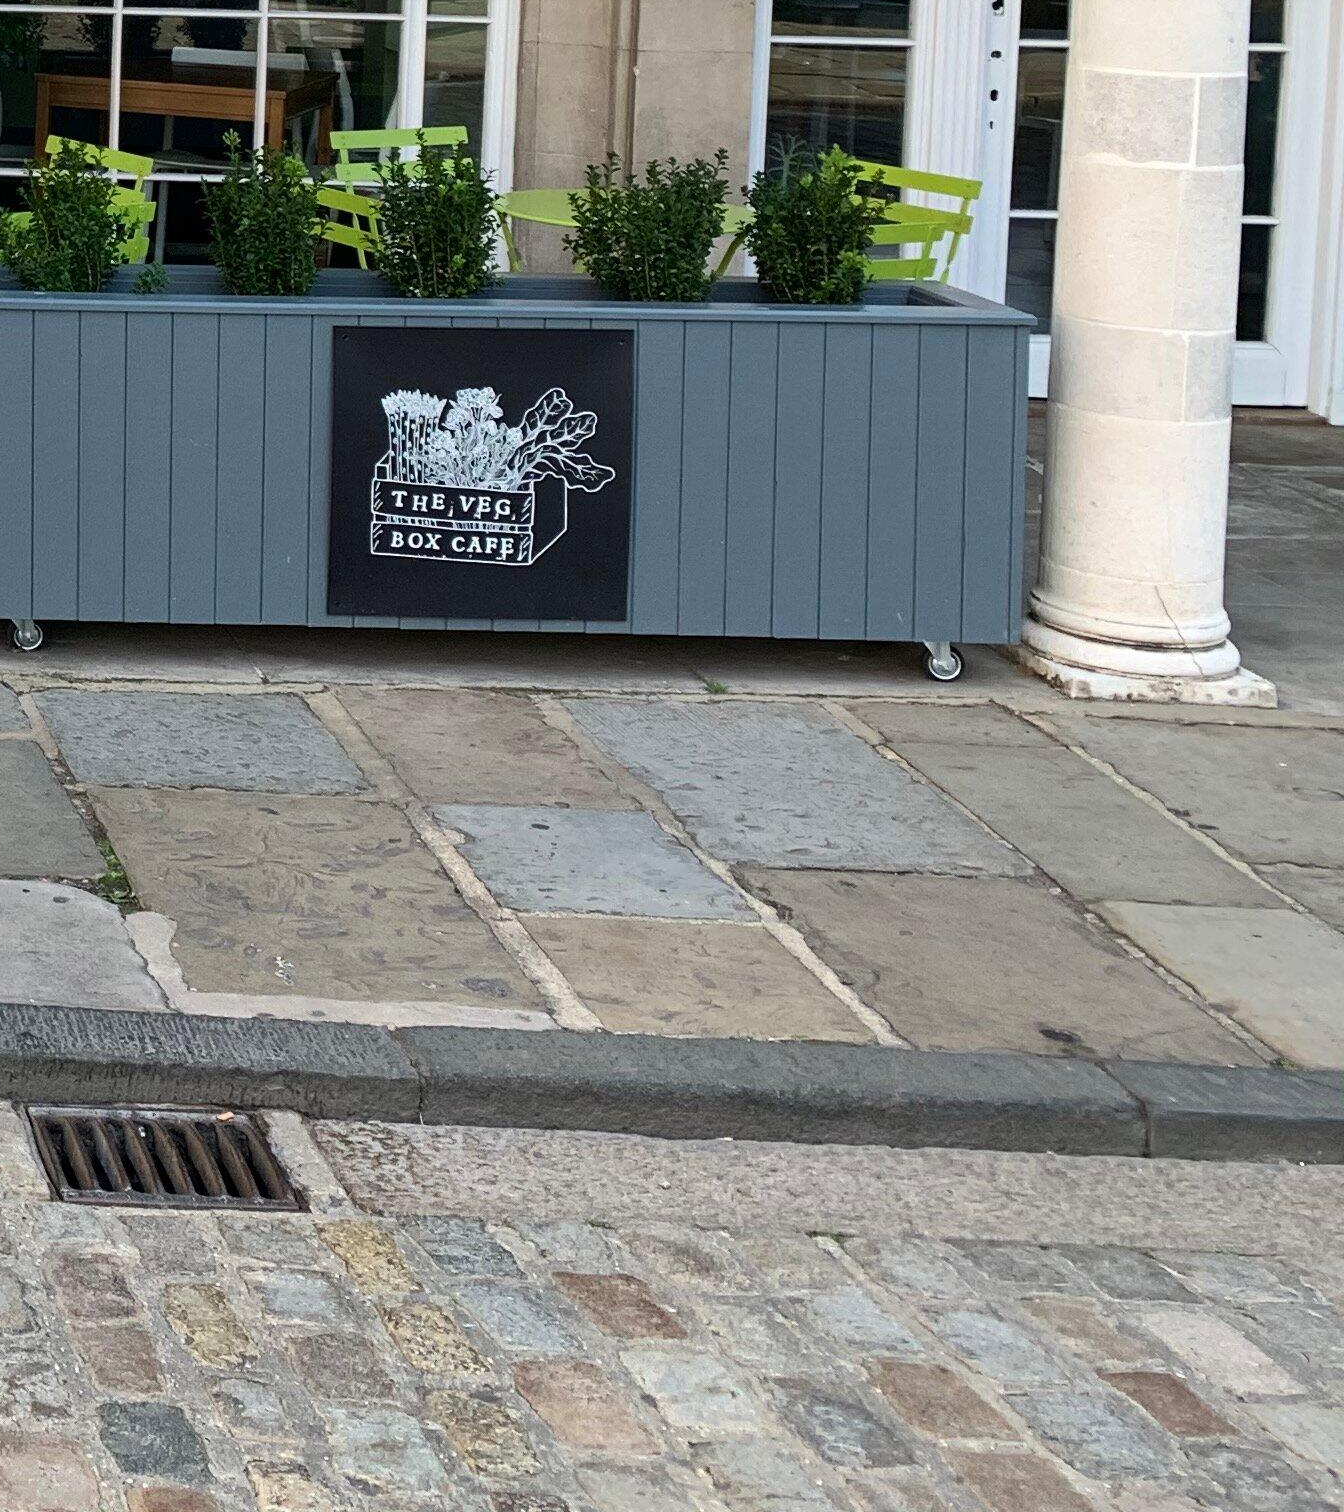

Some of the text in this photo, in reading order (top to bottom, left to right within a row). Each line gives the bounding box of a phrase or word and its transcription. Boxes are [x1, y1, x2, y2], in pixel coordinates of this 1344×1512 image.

[391, 490, 512, 517] THE VEG
[391, 531, 515, 559] BOX CAFE
